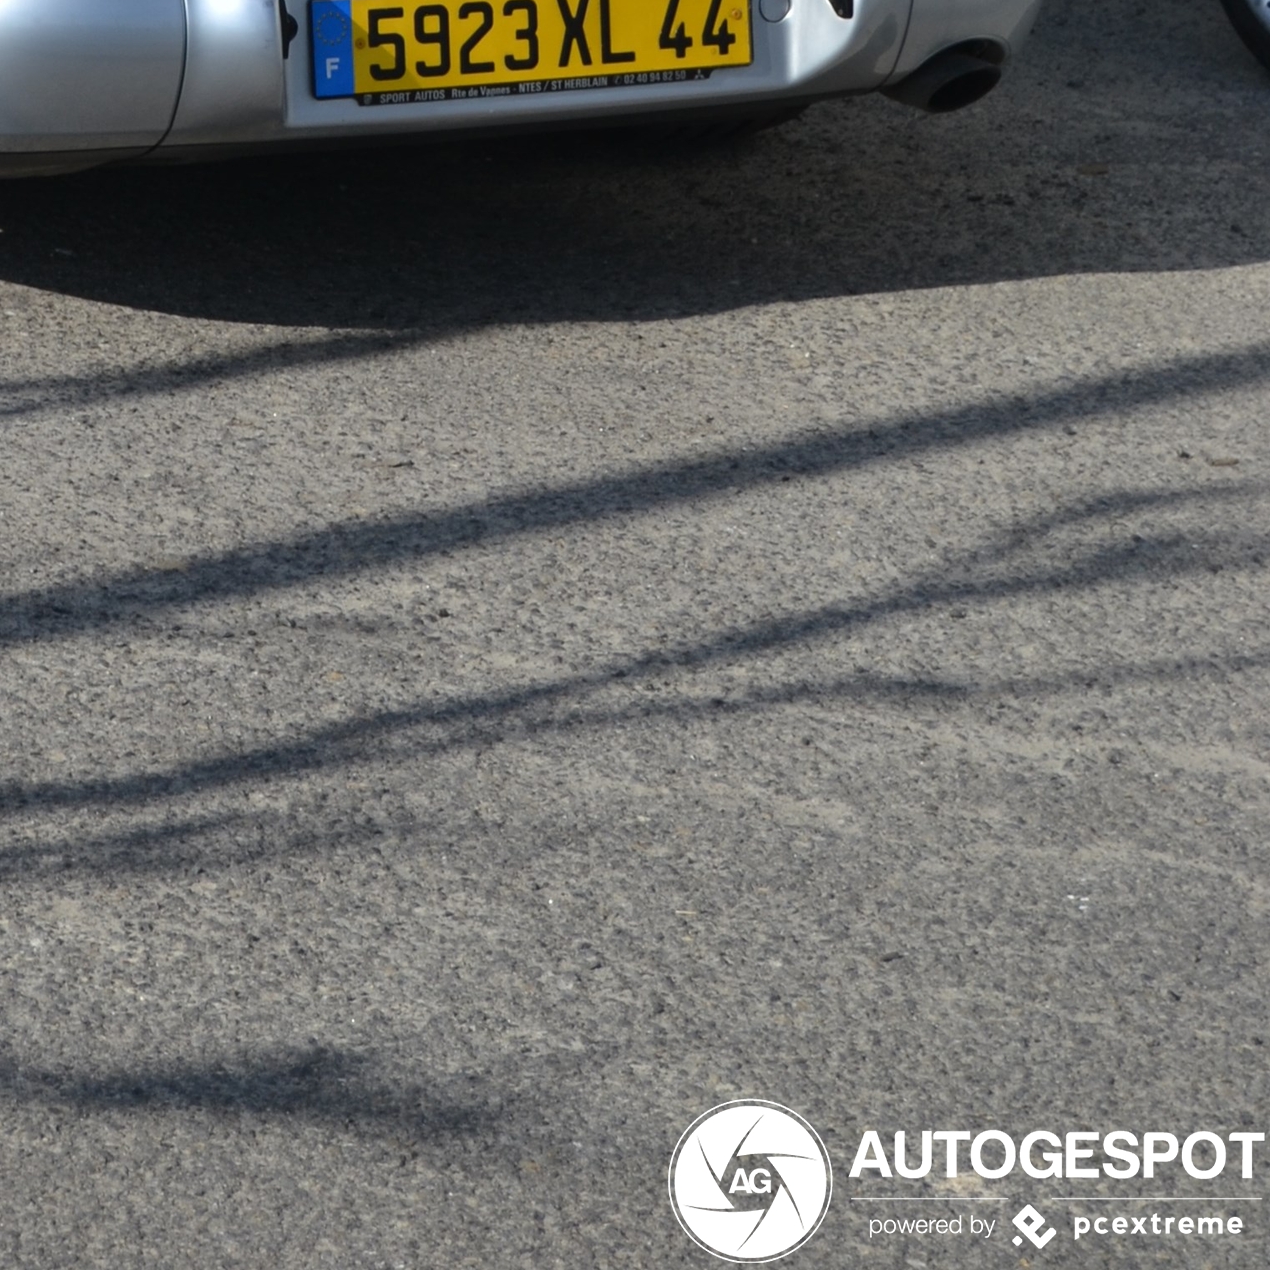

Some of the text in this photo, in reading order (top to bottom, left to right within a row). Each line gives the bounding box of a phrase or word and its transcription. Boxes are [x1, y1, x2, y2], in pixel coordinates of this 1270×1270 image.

[326, 57, 340, 80] F
[380, 91, 411, 104] SPORT
[414, 88, 446, 102] AUTOS
[451, 88, 467, 99] Rte
[469, 87, 480, 97] de
[518, 81, 542, 94] NTES
[551, 78, 563, 91] ST
[564, 75, 608, 90] HERBLAIN
[623, 73, 636, 85] 02
[636, 72, 649, 84] 40
[649, 72, 662, 83] 94
[662, 71, 674, 82] 82
[675, 69, 687, 80] 50
